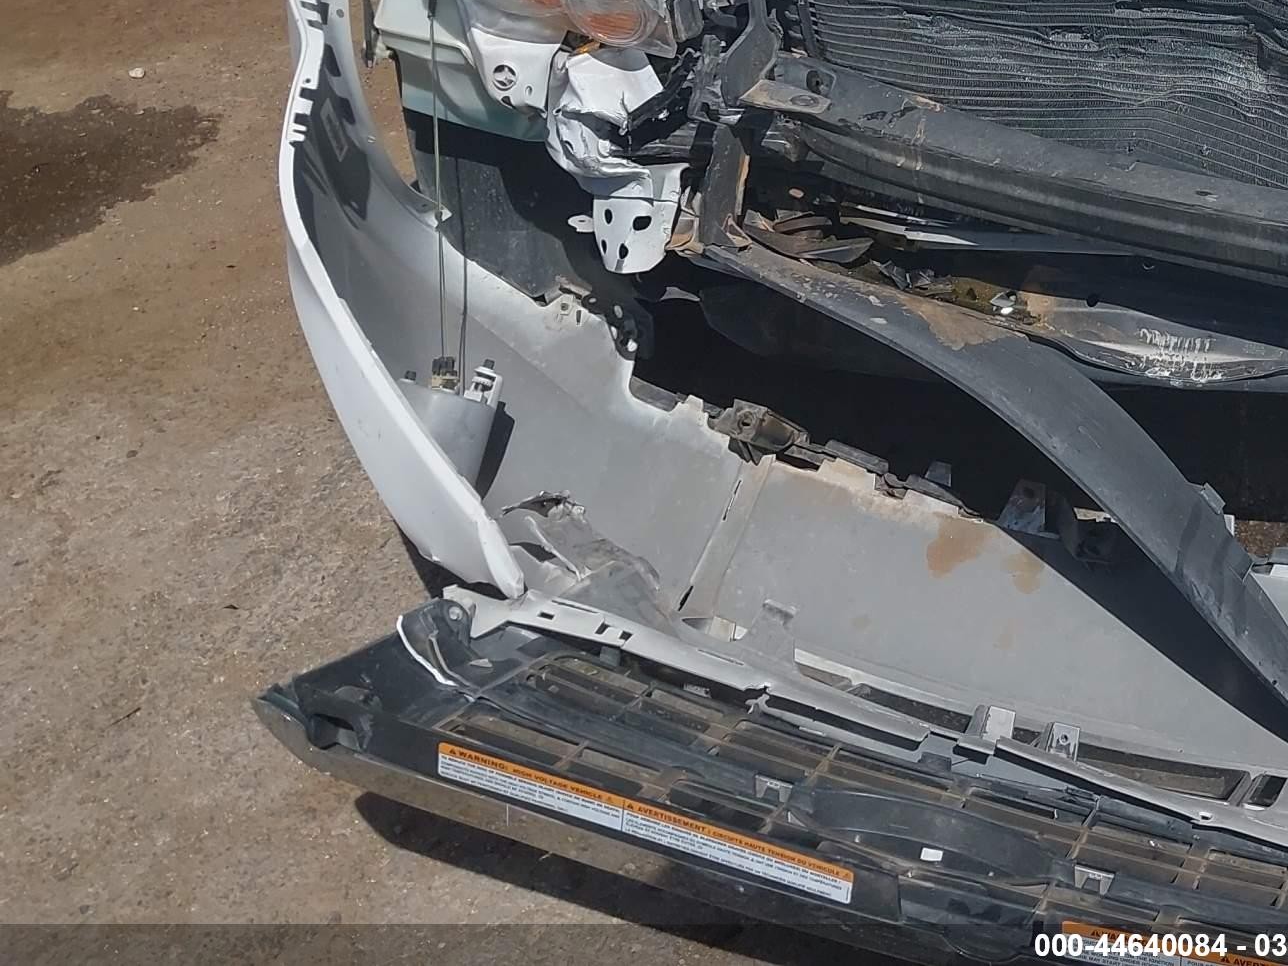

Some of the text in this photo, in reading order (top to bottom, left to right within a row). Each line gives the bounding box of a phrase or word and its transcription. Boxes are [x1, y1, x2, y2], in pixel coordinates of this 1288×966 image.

[458, 751, 509, 771] WARNING:
[534, 774, 569, 789] VOLTAGE
[570, 785, 602, 800] VEHICLE
[637, 806, 707, 832] AVERTISSEMENT
[744, 840, 766, 853] HAUTE
[767, 848, 797, 863] TENSION
